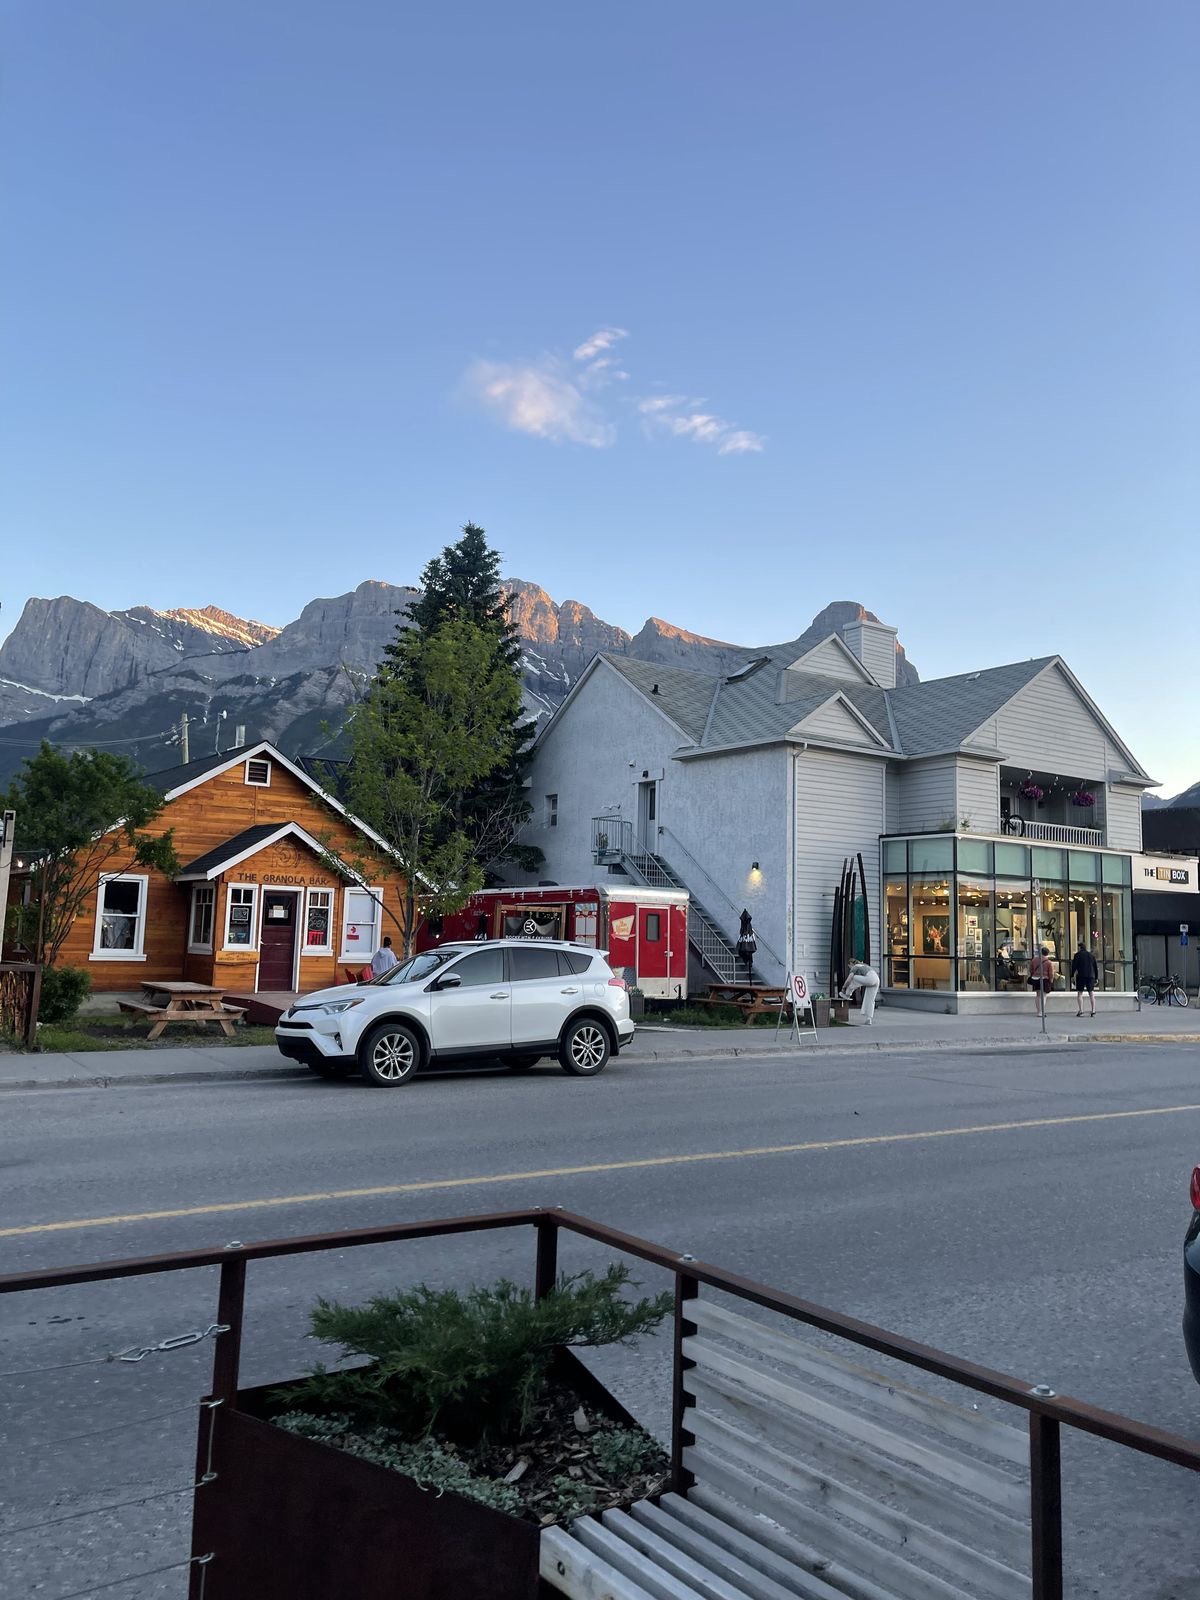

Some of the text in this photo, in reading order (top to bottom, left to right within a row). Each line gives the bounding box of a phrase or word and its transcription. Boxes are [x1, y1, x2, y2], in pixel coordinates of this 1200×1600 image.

[238, 873, 328, 885] THE GRANOLA BAR
[1144, 868, 1186, 880] THE TIN BOX
